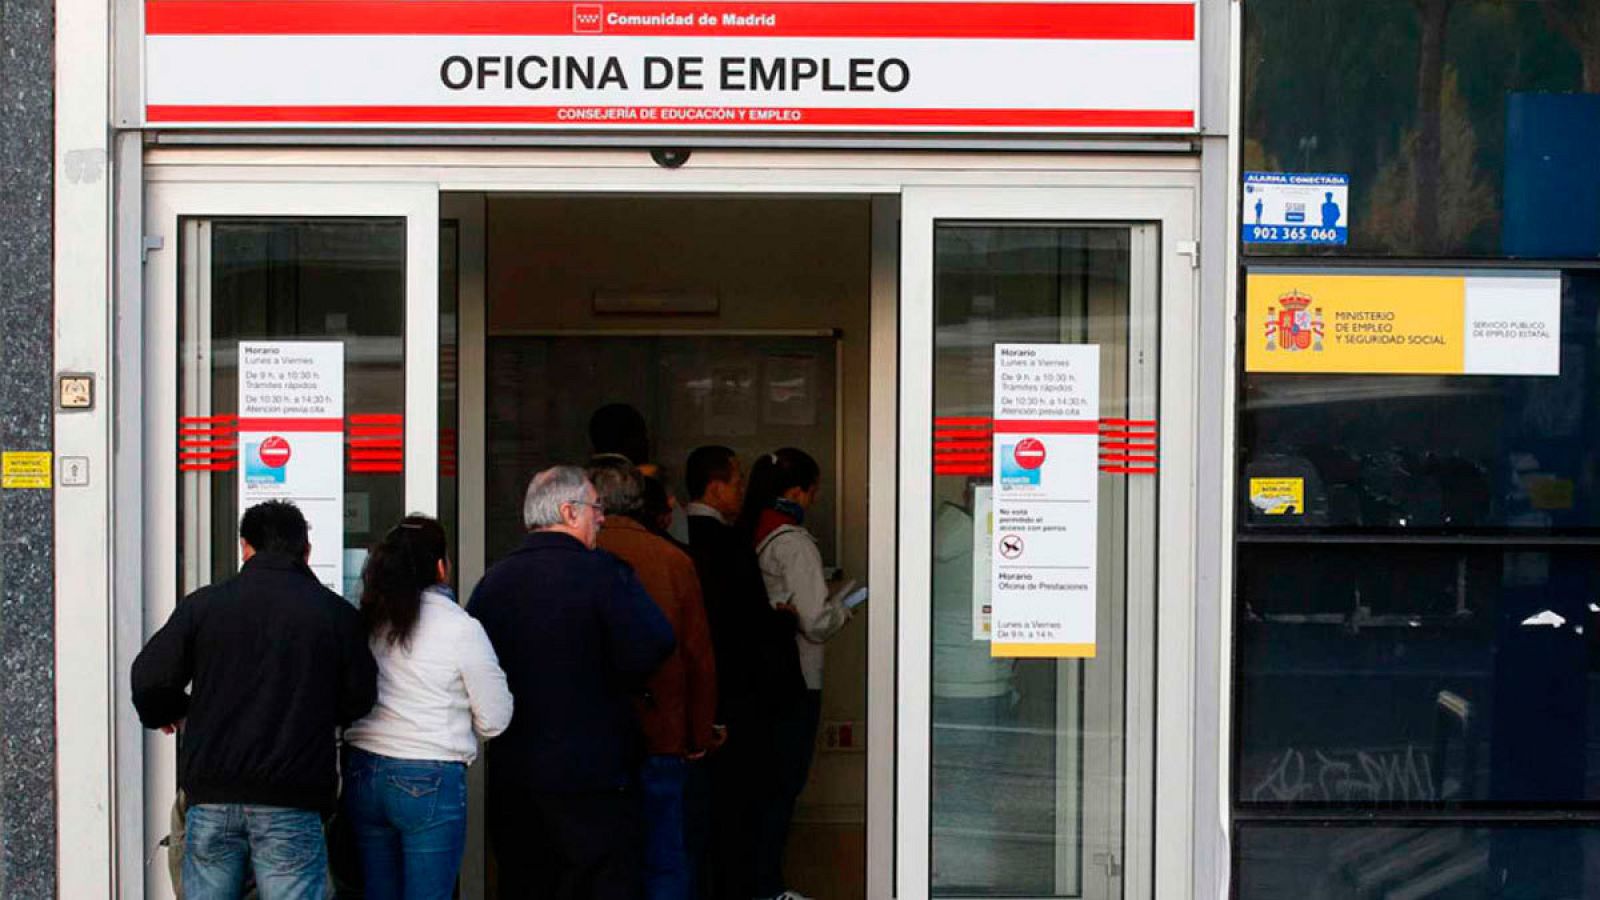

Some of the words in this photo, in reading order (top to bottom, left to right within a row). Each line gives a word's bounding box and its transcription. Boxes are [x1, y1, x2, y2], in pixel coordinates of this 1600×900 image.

[607, 12, 693, 25] Comunidad
[699, 13, 717, 25] de
[722, 13, 776, 25] Madrid
[439, 55, 628, 90] OFICINA
[643, 56, 703, 90] DE
[719, 57, 910, 92] EMPLEO
[557, 107, 637, 120] CONSEJERÍA
[640, 108, 657, 120] DE
[661, 107, 735, 120] EDUCACIÓN
[738, 109, 747, 120] Y
[750, 109, 801, 121] EMPLEO
[1247, 175, 1287, 184] ALARMA
[1290, 176, 1345, 184] CONECTADA
[1253, 227, 1278, 239] 902
[1282, 228, 1306, 240] 365
[1311, 228, 1337, 241] 060
[1335, 311, 1395, 321] MINISTERIO
[1335, 323, 1349, 332] DE
[1351, 323, 1393, 333] EMPLEO
[1472, 321, 1509, 330] SERVICIO
[1472, 330, 1484, 338] DE
[1485, 330, 1517, 338] EMPLEO
[1518, 330, 1550, 339] ESTATAL
[1335, 335, 1342, 344] Y
[1344, 335, 1405, 345] SEGURIDAD
[1407, 335, 1446, 345] SOCIAL
[245, 346, 280, 354] Horario
[1001, 348, 1037, 357] Horario
[245, 357, 272, 365] Lunes
[281, 357, 314, 365] Viernes
[1001, 359, 1027, 367] Lunes
[1038, 359, 1070, 367] Viernes
[245, 371, 257, 380] De
[1002, 373, 1014, 381] De
[245, 395, 257, 403] De
[1001, 396, 1013, 405] De
[998, 582, 1025, 590] Oficina
[1027, 582, 1037, 590] de
[1039, 582, 1089, 590] Prestaciones
[997, 621, 1023, 629] Lunes
[1031, 620, 1062, 629] Viernes
[997, 631, 1009, 639] De
